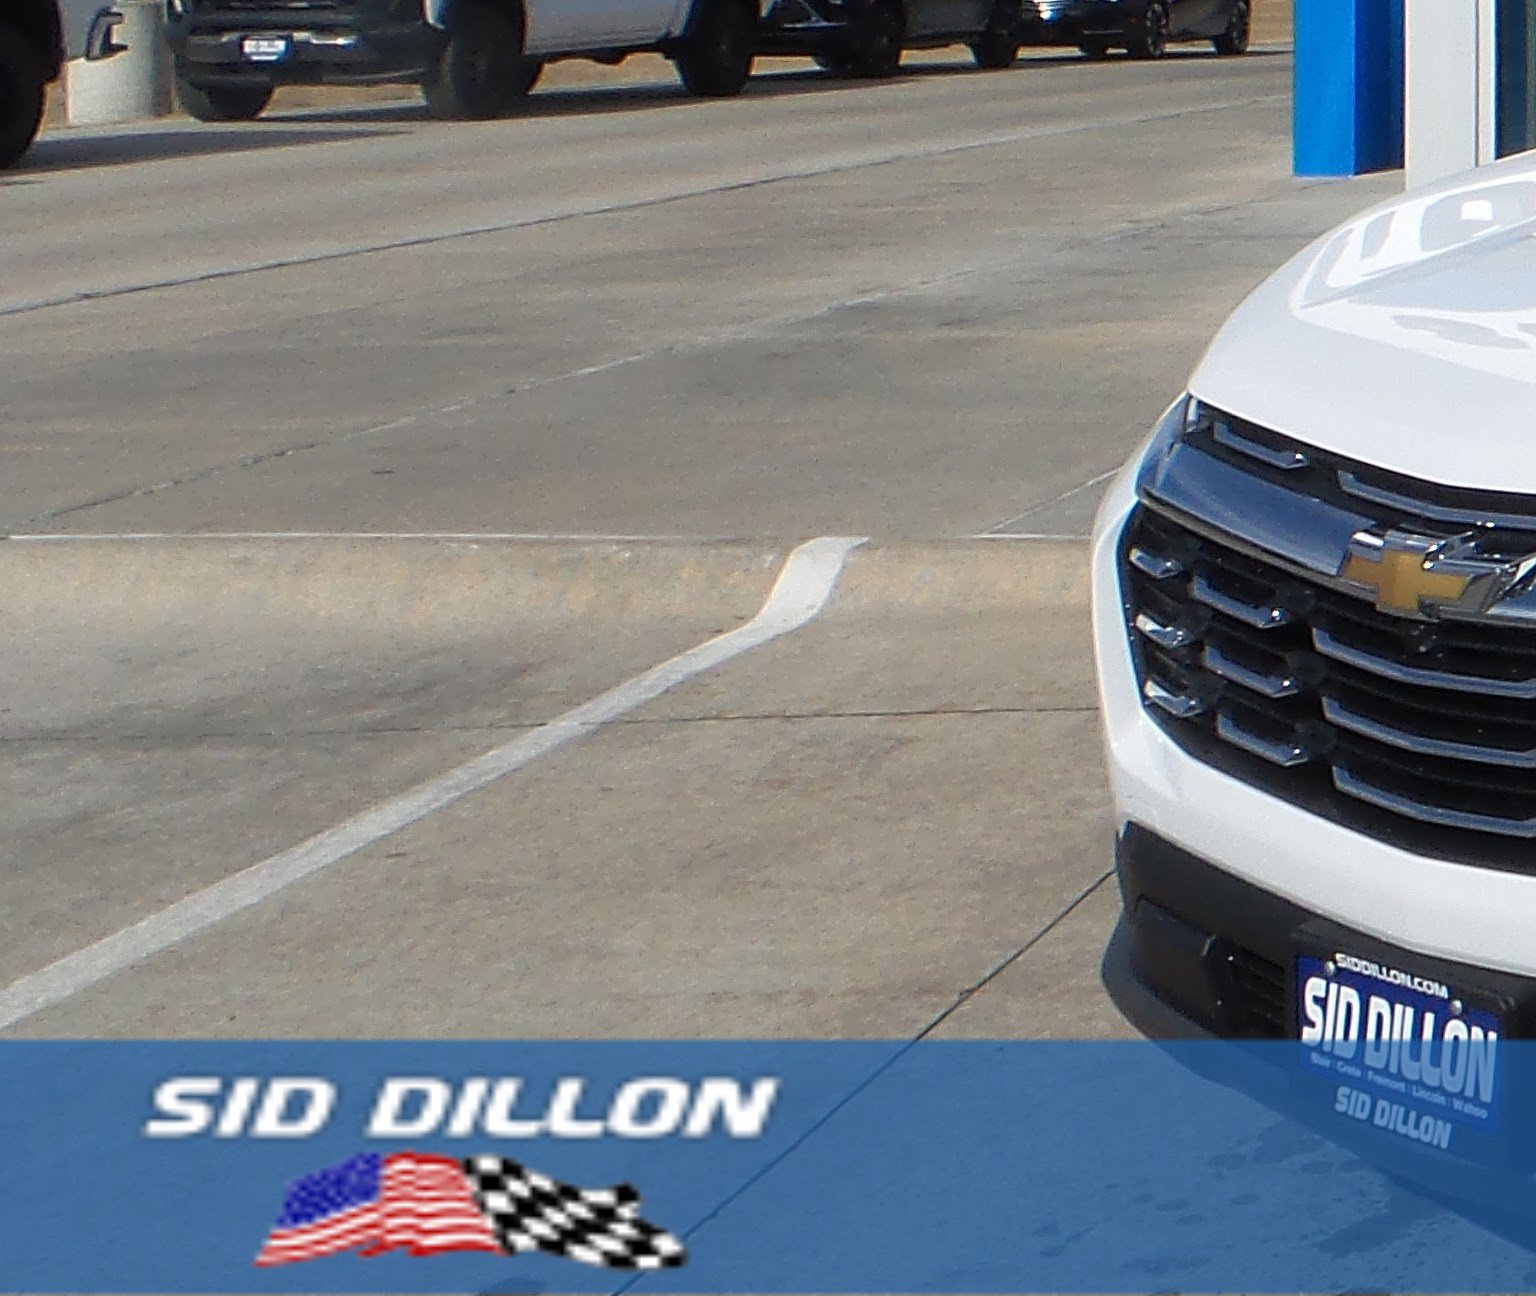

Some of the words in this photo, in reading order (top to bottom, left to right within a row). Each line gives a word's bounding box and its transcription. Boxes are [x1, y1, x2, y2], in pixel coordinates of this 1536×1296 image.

[1336, 953, 1449, 1000] SIDDILLON.COM
[1302, 976, 1361, 1059] SID
[1364, 995, 1498, 1104] DILLON
[1334, 1085, 1372, 1120] SID
[1373, 1098, 1453, 1150] DILLON
